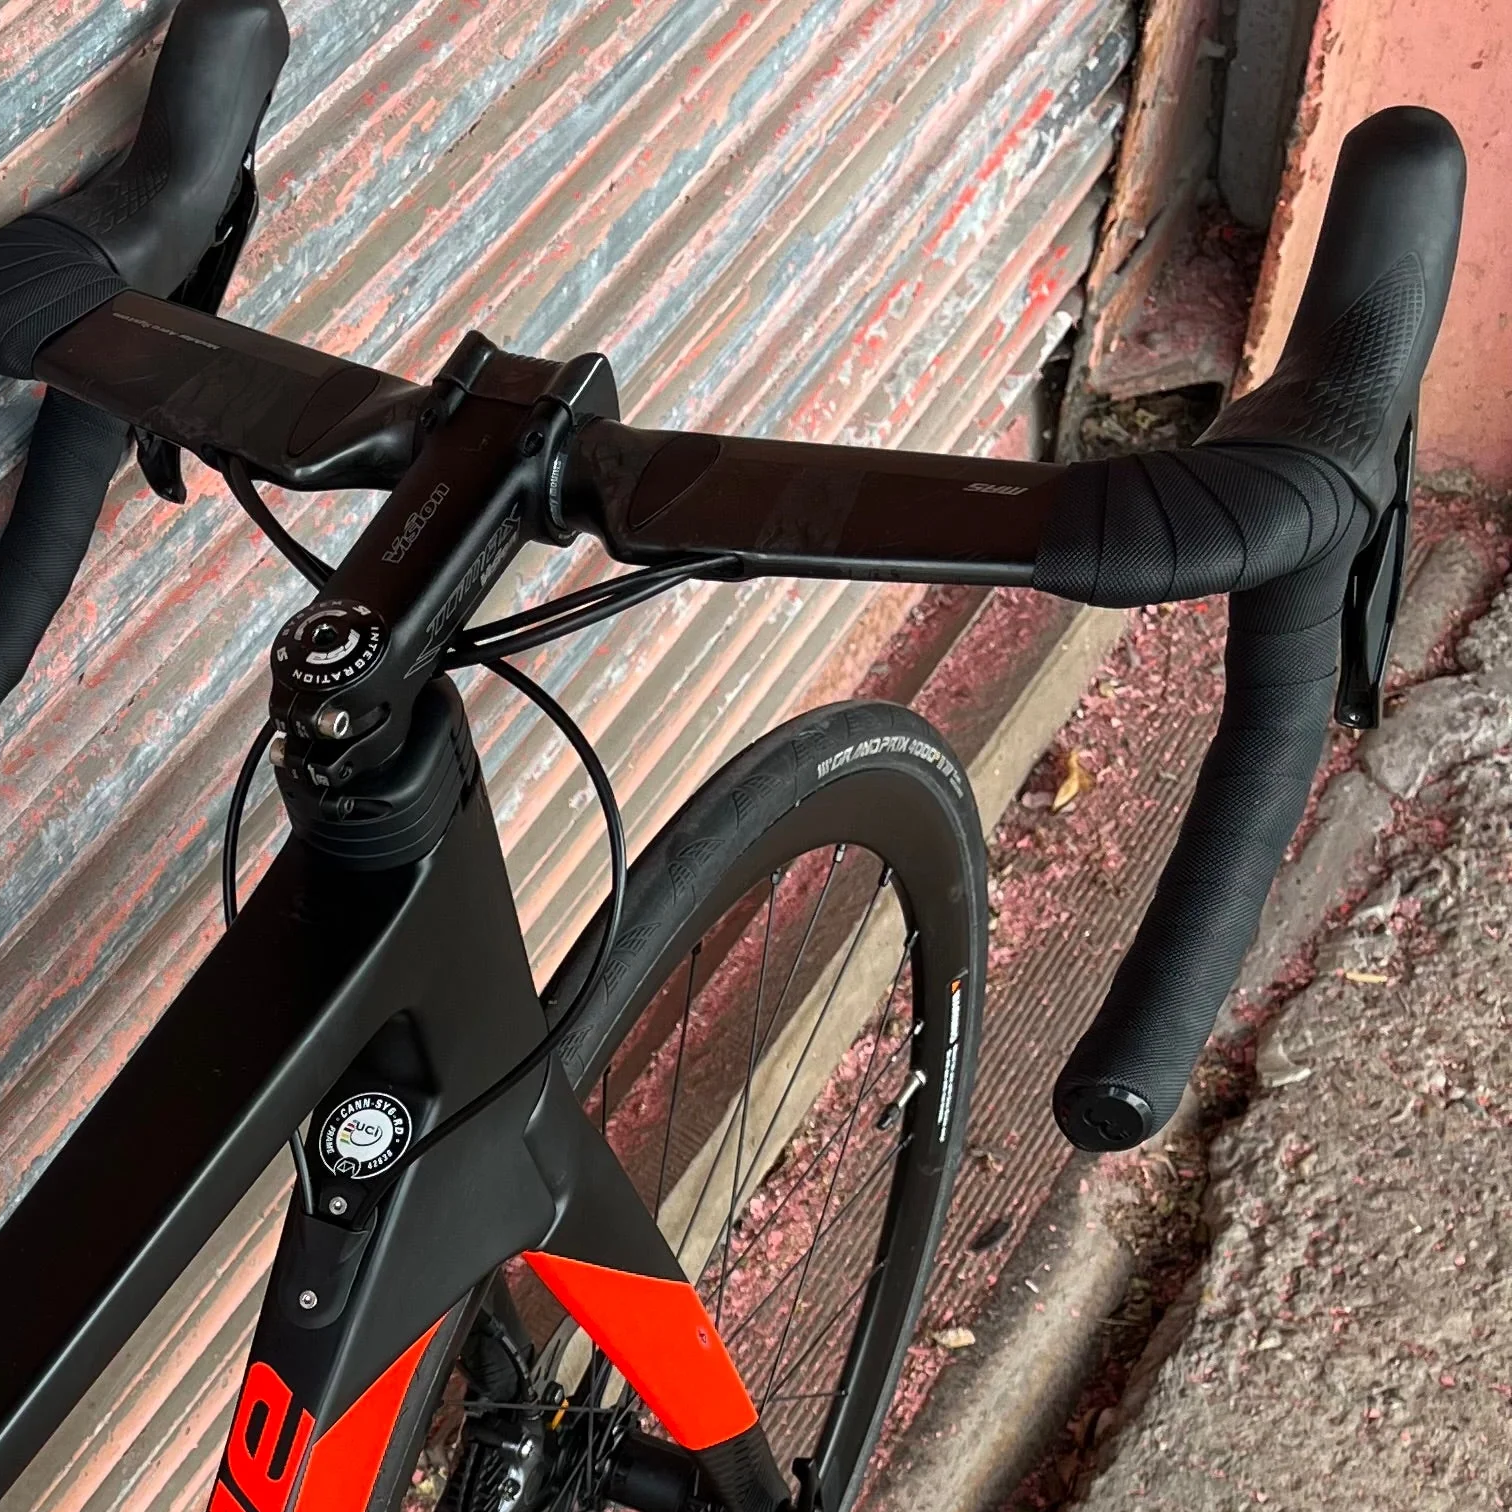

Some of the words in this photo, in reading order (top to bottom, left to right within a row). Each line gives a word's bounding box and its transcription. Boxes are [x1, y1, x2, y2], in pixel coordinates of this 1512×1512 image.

[382, 482, 450, 565] Vision
[291, 625, 380, 684] INTEGRATION
[354, 1119, 380, 1138] UCI
